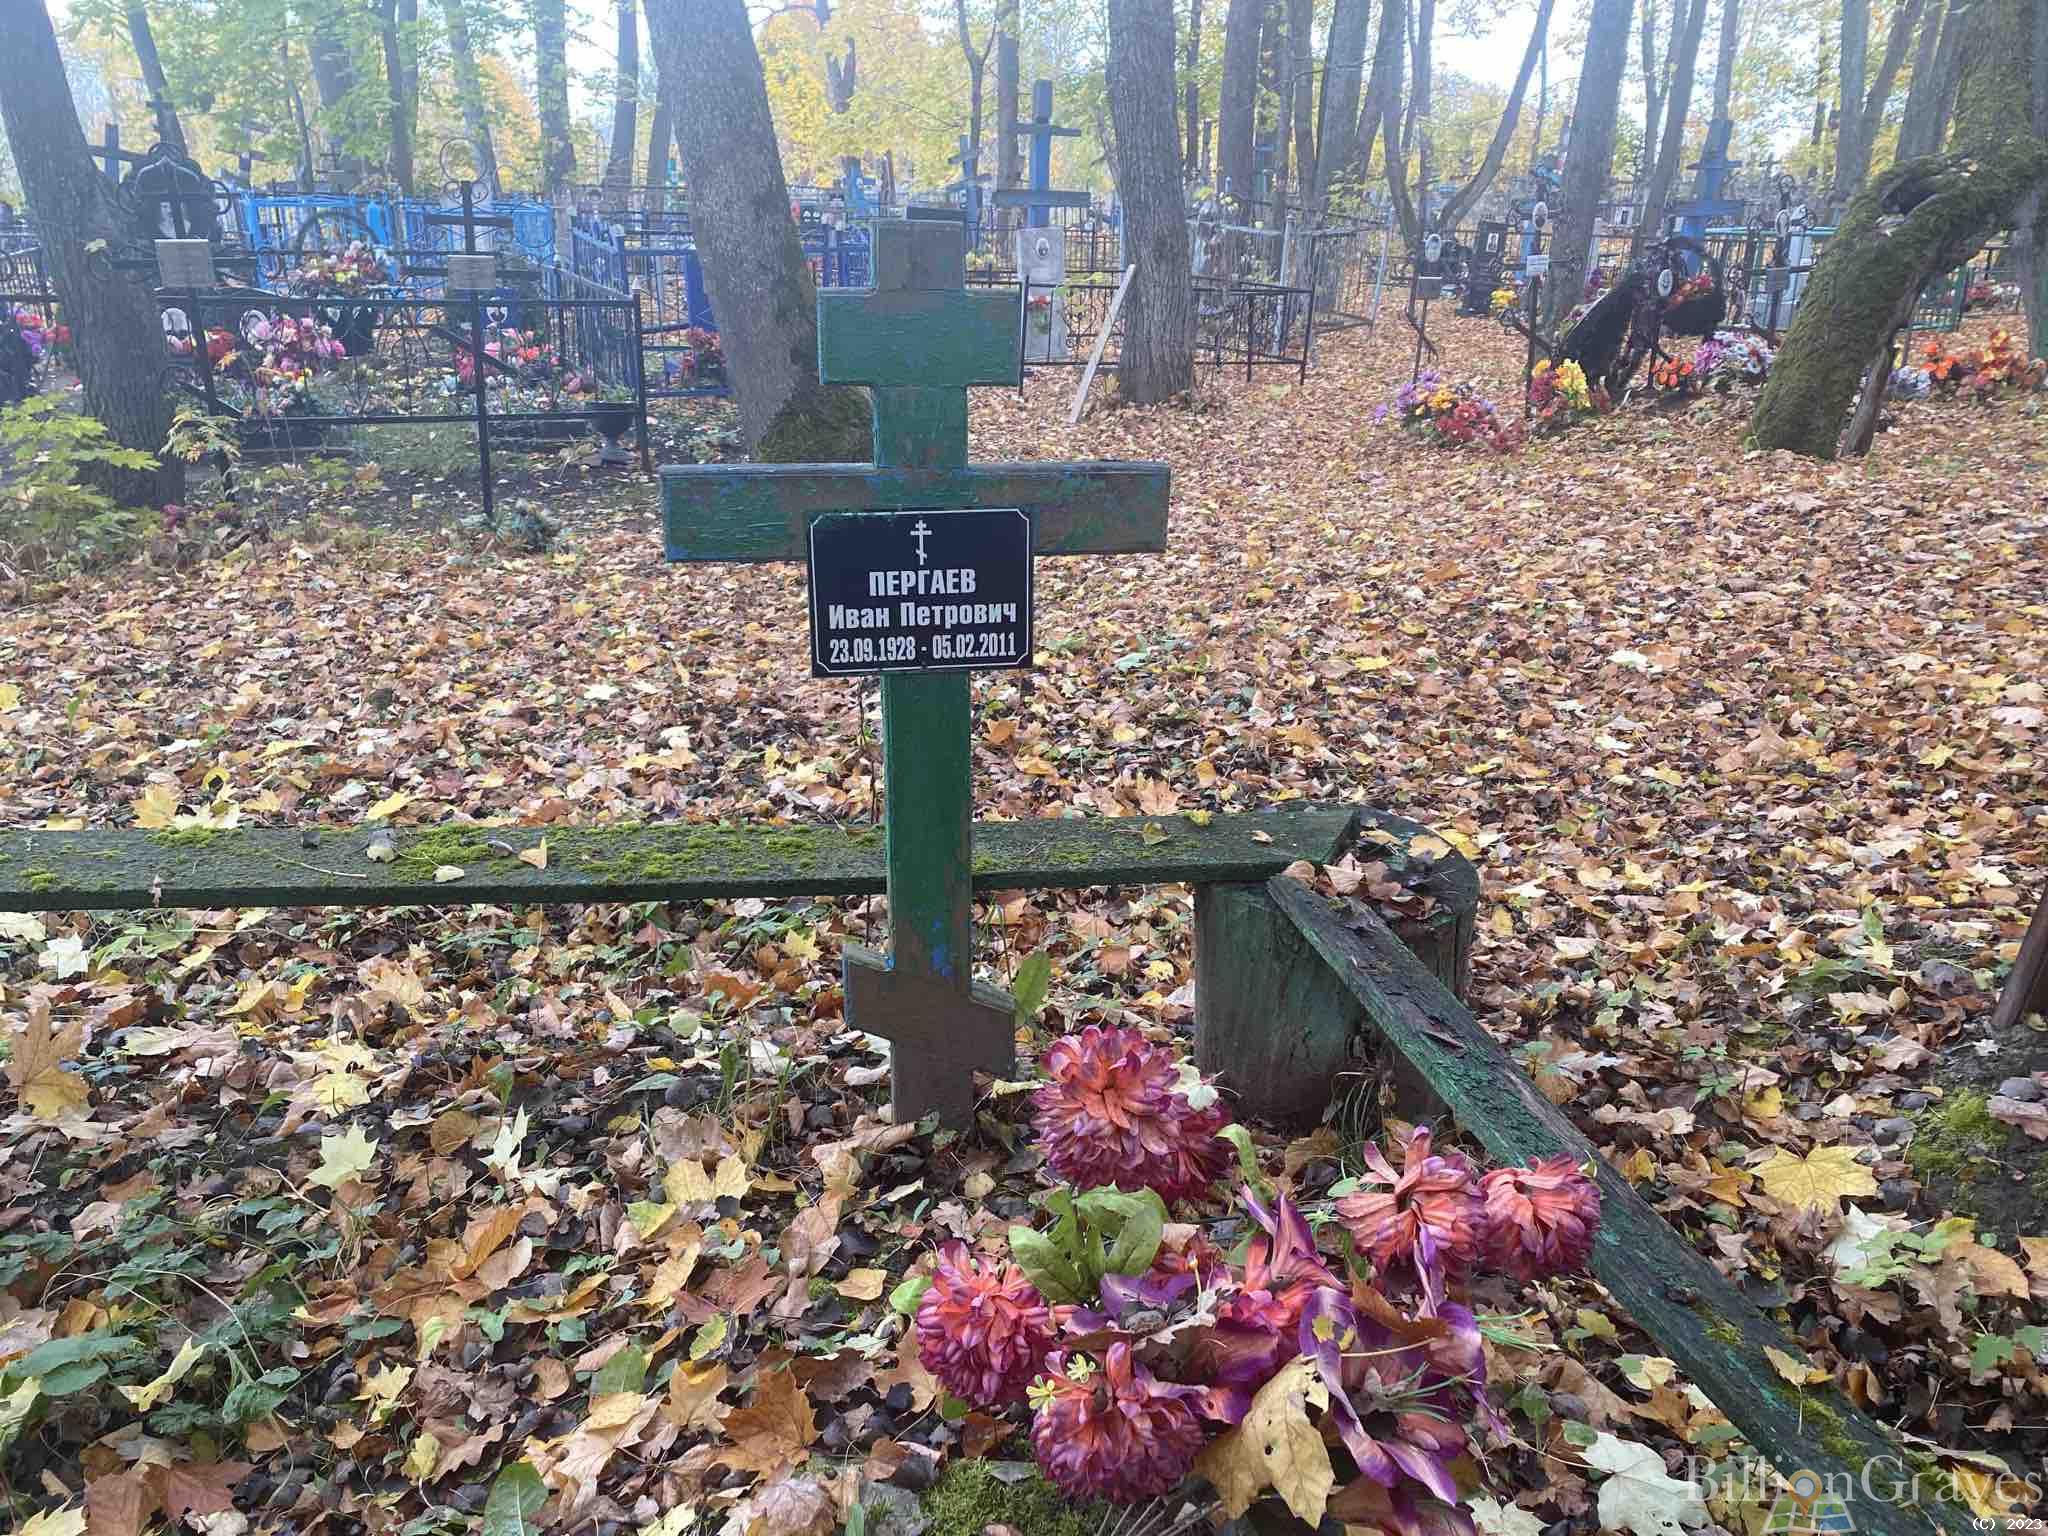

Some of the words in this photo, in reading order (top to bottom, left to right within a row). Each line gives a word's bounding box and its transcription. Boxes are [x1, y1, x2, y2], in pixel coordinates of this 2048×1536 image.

[868, 568, 976, 597] ПЕРГАЕВ
[829, 605, 890, 630] Иван
[900, 602, 1017, 630] Петрович
[829, 636, 916, 664] 23.09.1928
[932, 632, 1016, 659] 05.02.2011
